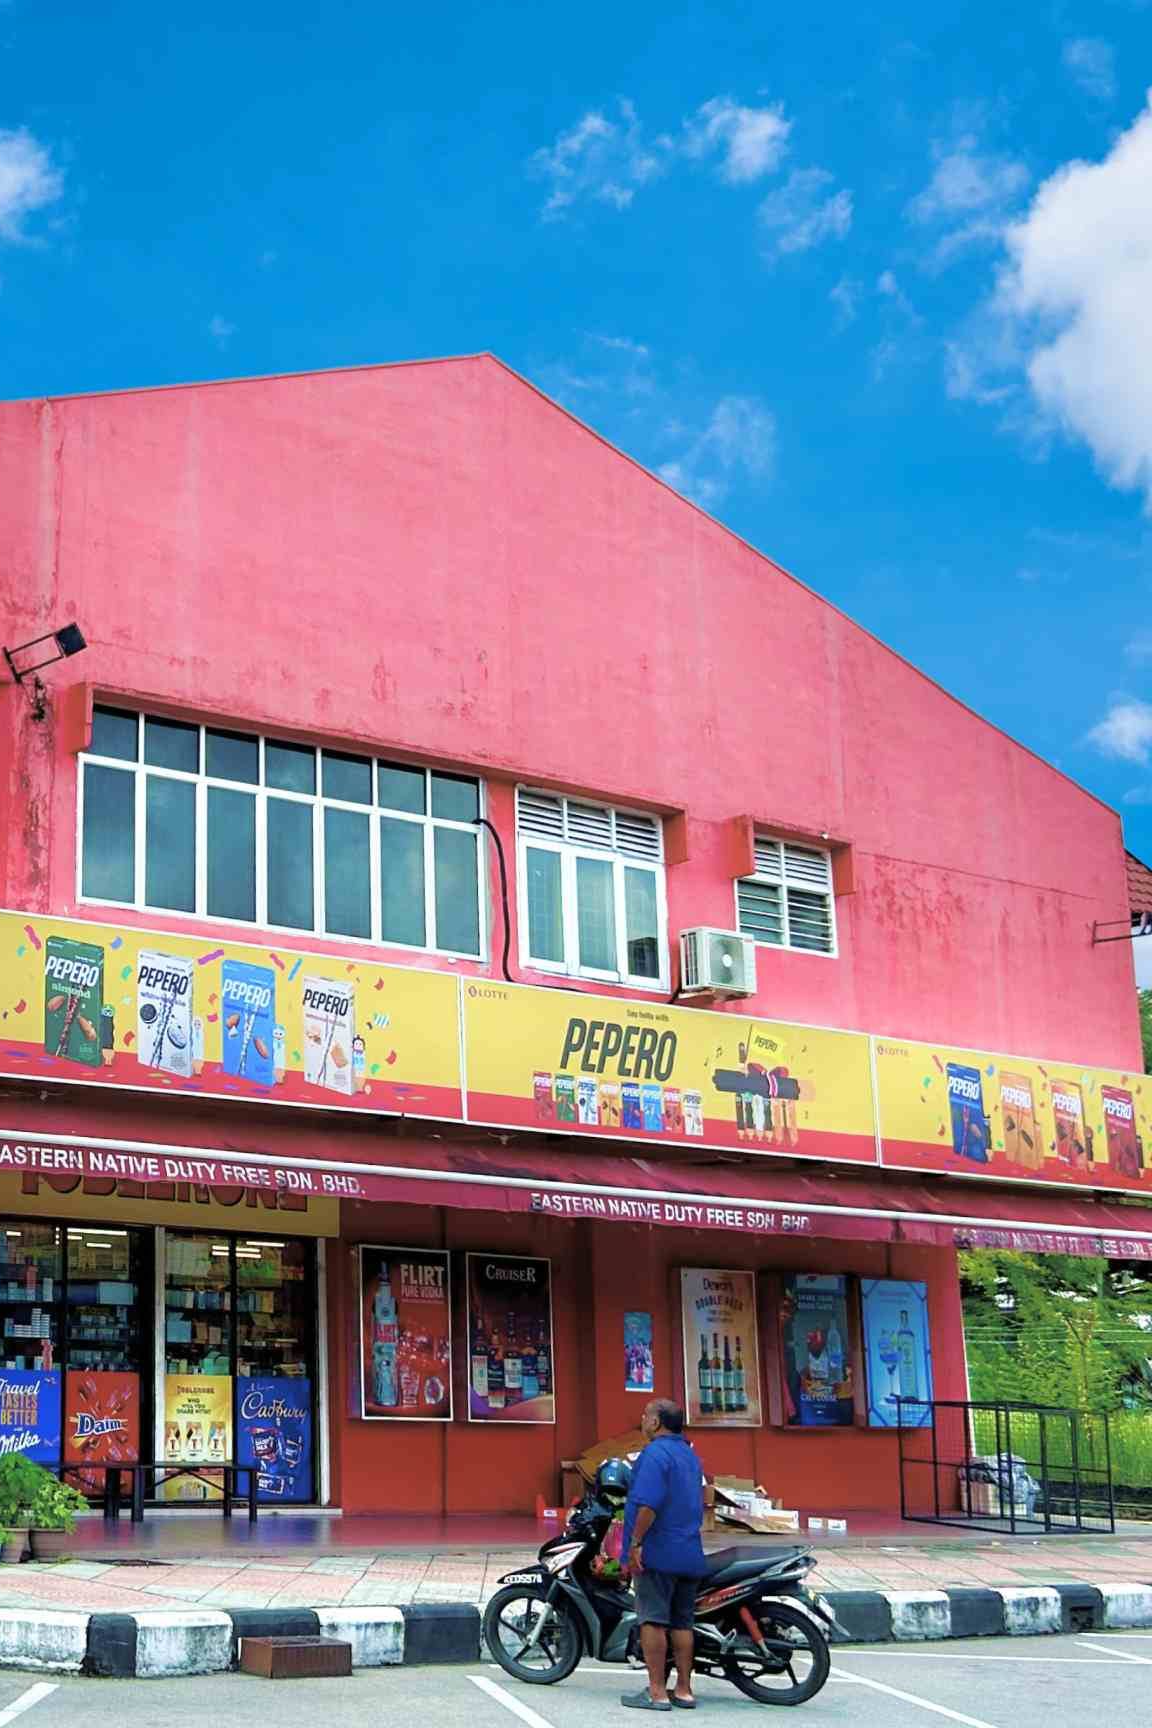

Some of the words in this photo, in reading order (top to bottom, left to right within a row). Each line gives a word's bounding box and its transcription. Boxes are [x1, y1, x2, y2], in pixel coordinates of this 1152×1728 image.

[45, 954, 100, 988] PEPERO
[137, 965, 189, 996] PEPERO
[222, 978, 272, 1009] PEPERO
[302, 988, 349, 1017] PEPERO
[479, 989, 509, 1000] LOTTE
[560, 1017, 678, 1082] PEPERO
[754, 1034, 778, 1052] PEPERO
[948, 1075, 981, 1100] PEPERO
[1001, 1085, 1032, 1109] PEPERO
[1052, 1092, 1082, 1116] PEPERO
[1103, 1098, 1132, 1121] PEPERO
[89, 1151, 160, 1176] NATIVE
[164, 1158, 216, 1181] DUTY
[222, 1165, 271, 1187] FREE
[274, 1169, 319, 1191] SDN.
[323, 1174, 366, 1195] BHD.
[530, 1192, 605, 1214] EASTERN
[607, 1199, 661, 1220] NATIVE
[665, 1203, 704, 1223] DUTY
[707, 1208, 744, 1227] FREE
[1055, 1236, 1086, 1252] DUT
[400, 1263, 445, 1287] FLIRT
[401, 1285, 419, 1298] PURE
[420, 1286, 445, 1299] VODKA
[1, 1393, 38, 1409] TASTES
[241, 1391, 307, 1425] Cadbury
[0, 1409, 38, 1425] BETTER
[77, 1413, 122, 1436] Daim
